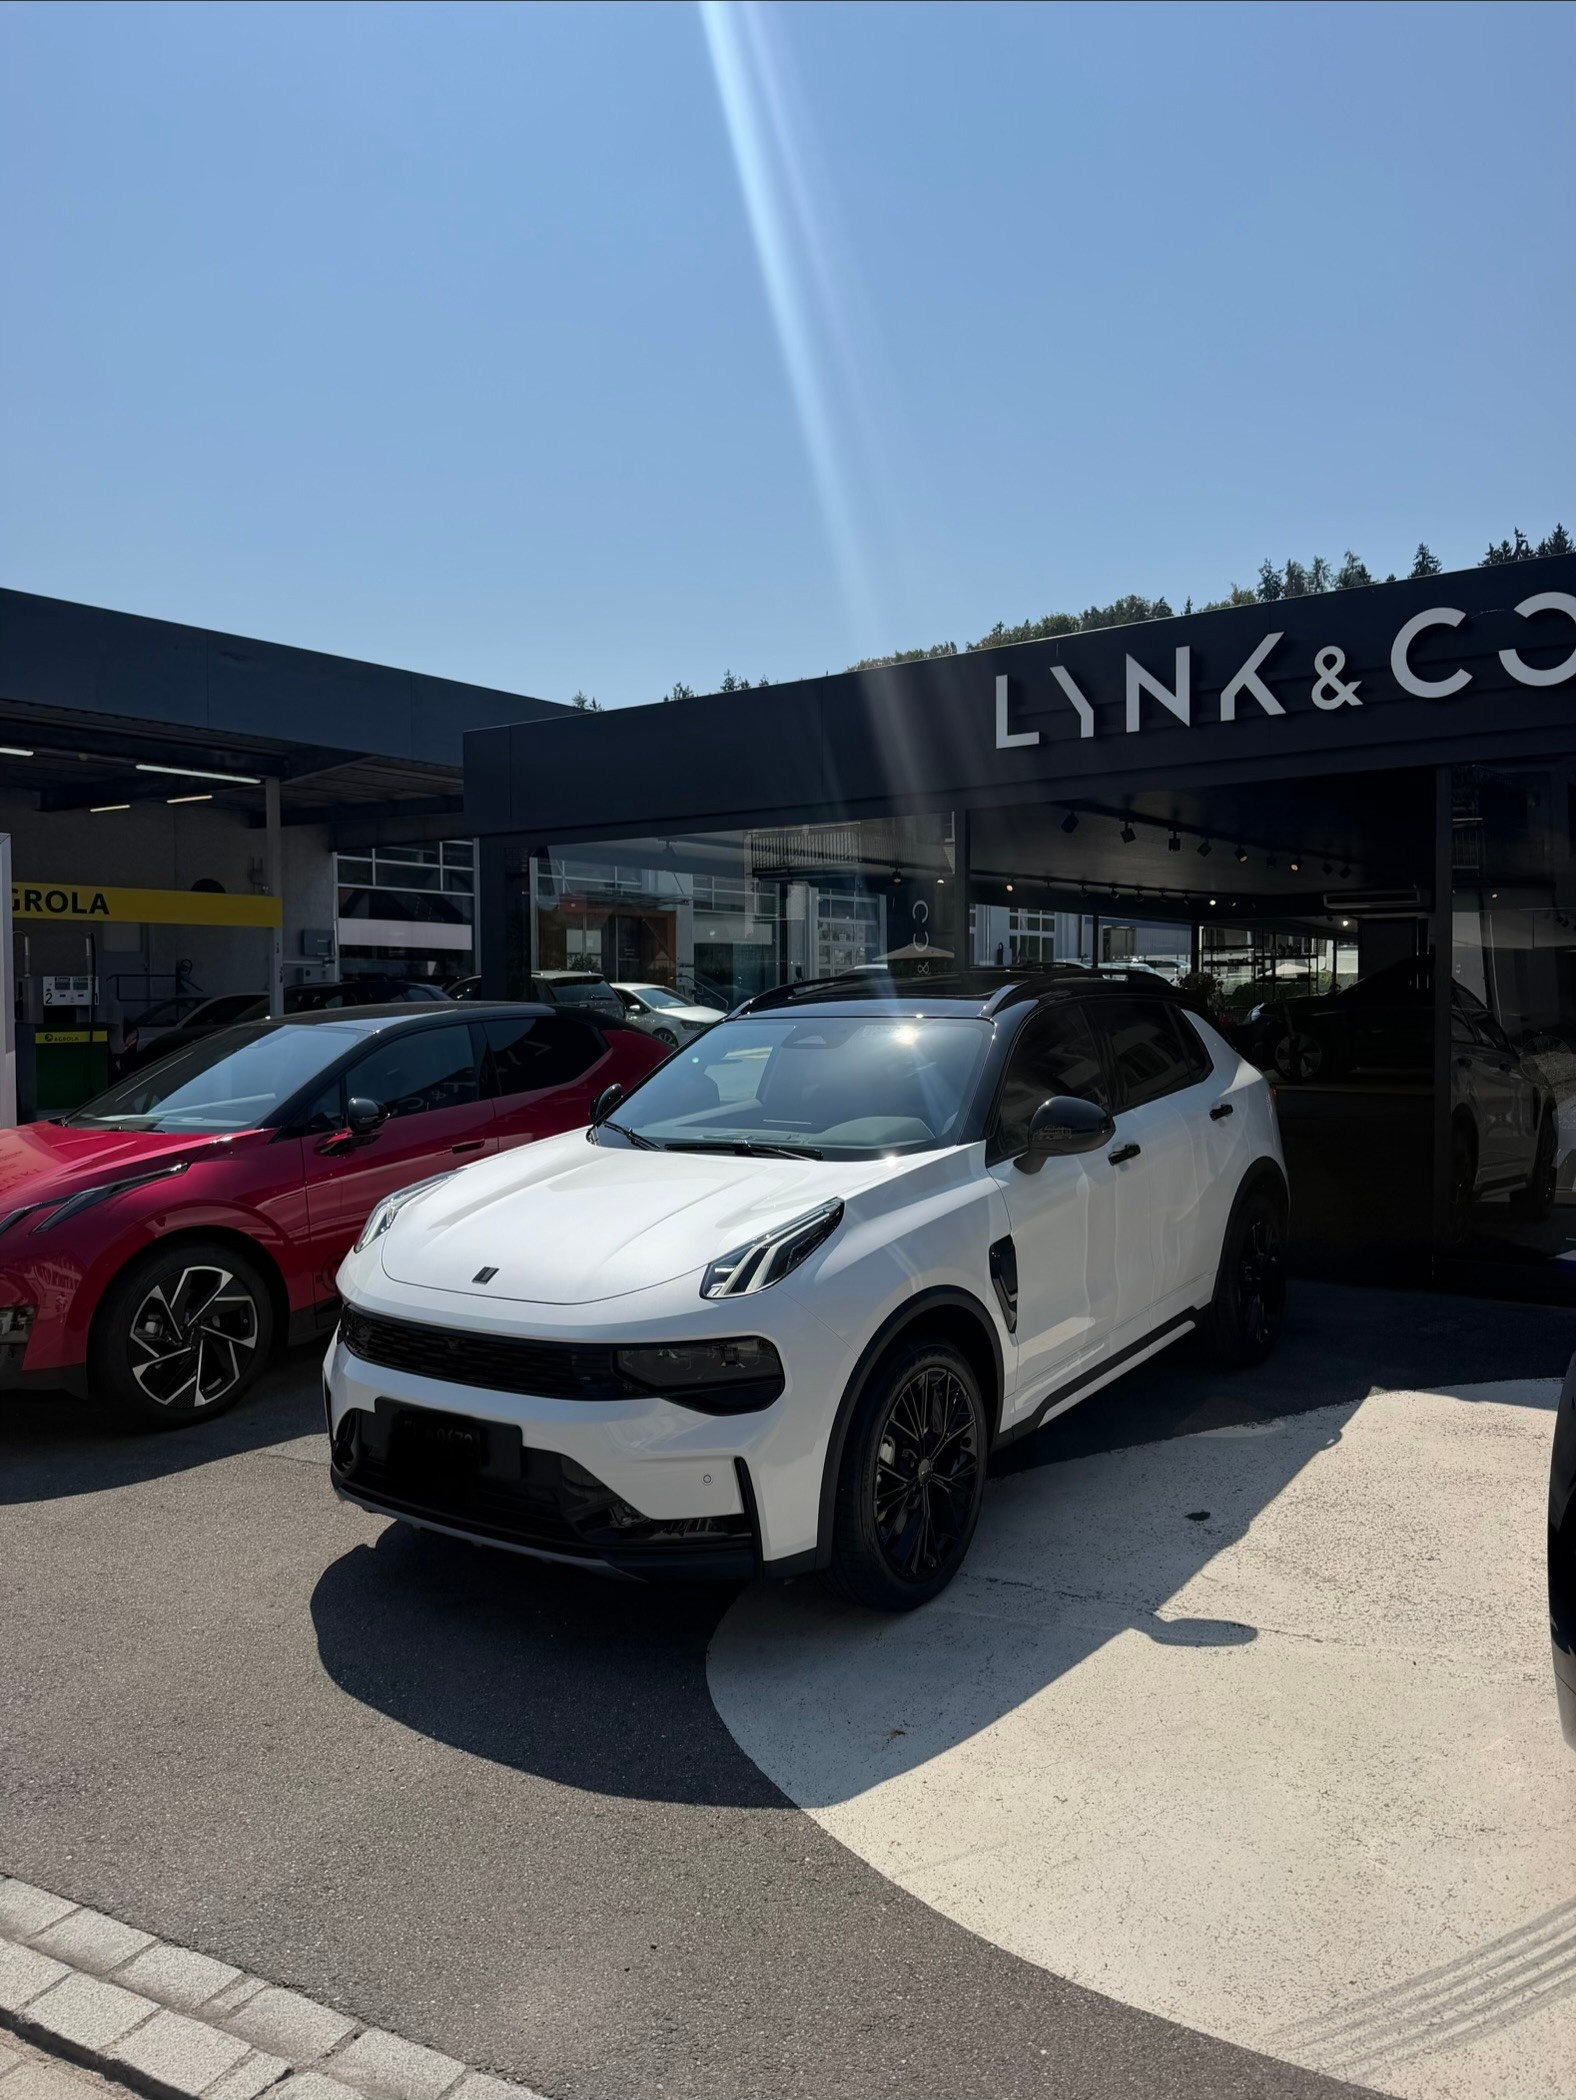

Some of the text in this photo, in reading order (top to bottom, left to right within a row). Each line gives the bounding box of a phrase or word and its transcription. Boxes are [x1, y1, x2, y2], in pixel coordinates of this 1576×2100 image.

[996, 632, 1286, 748] LYNK
[1311, 645, 1363, 710] &
[45, 992, 53, 1004] 2
